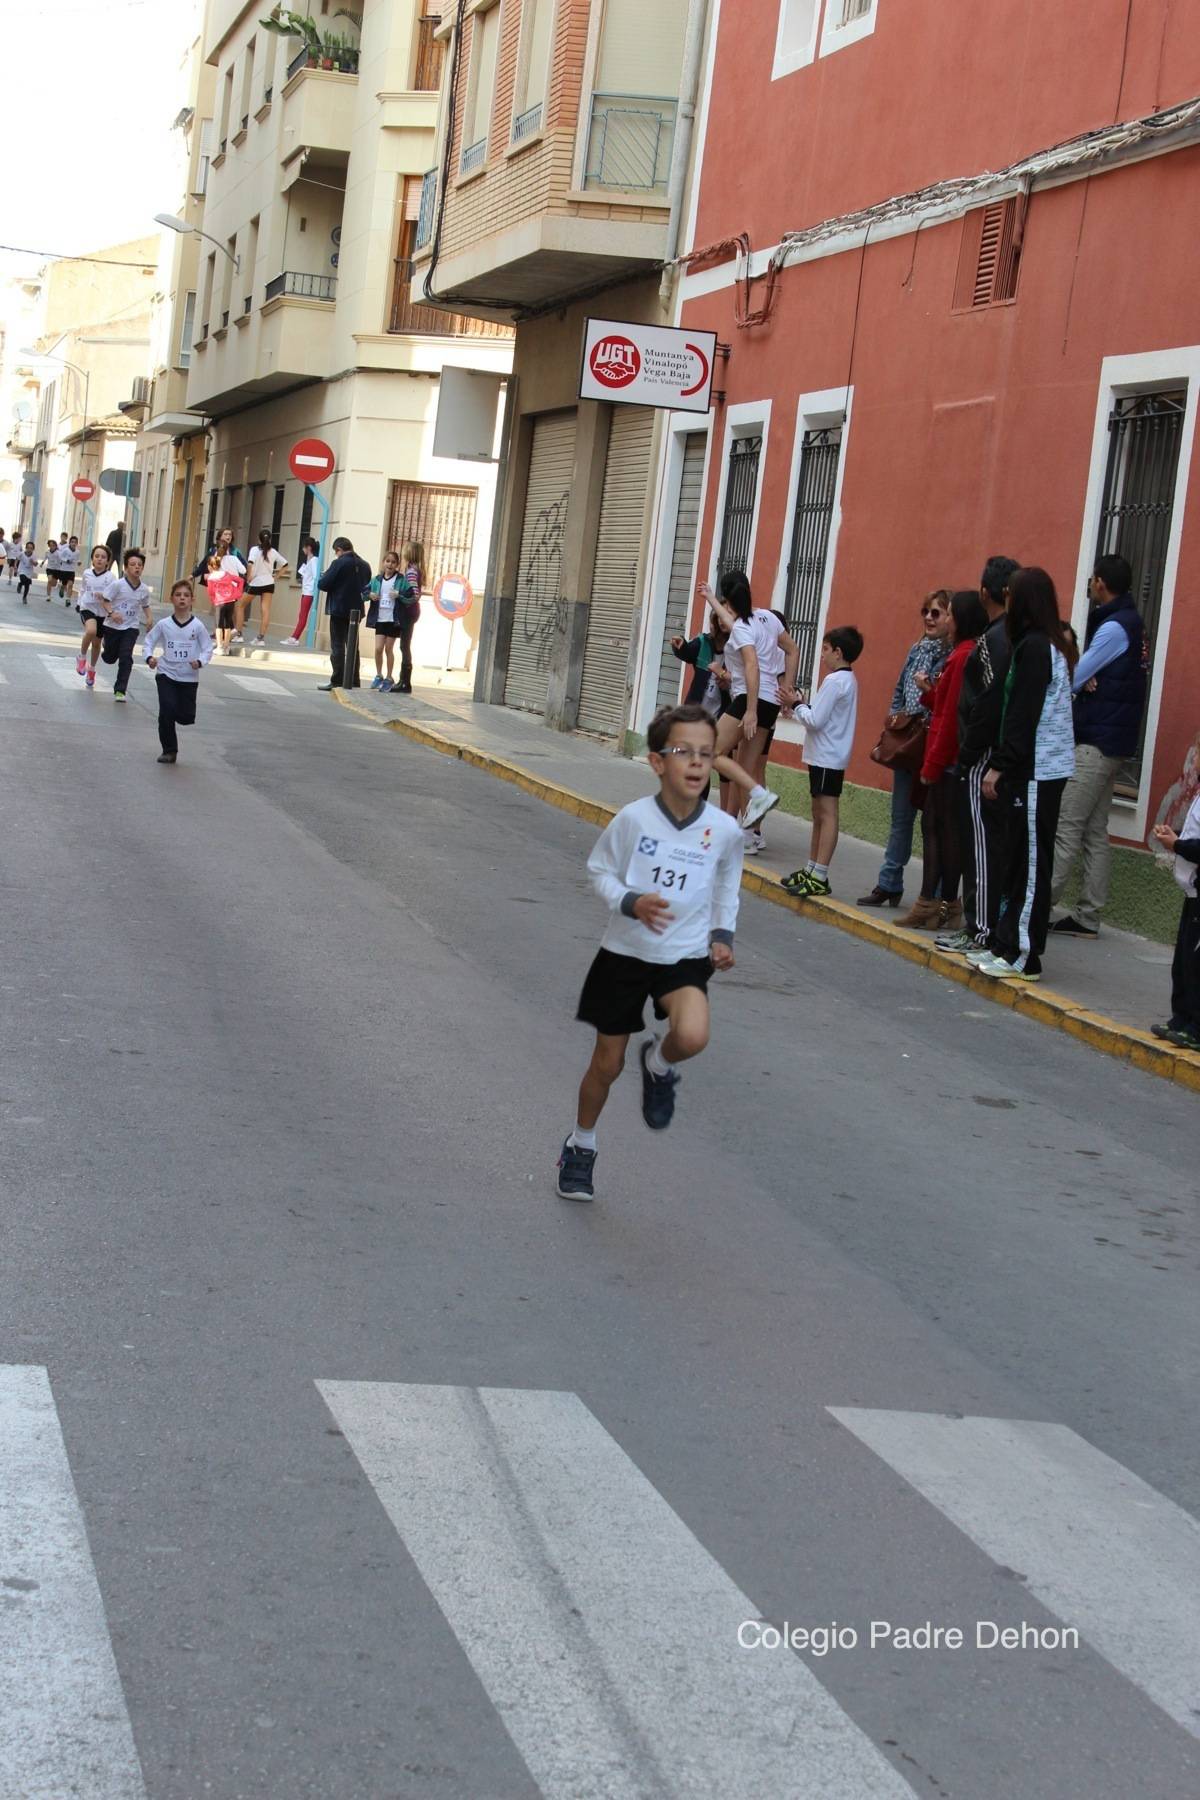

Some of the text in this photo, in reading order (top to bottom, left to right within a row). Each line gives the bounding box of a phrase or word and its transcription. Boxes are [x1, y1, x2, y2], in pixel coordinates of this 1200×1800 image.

[596, 342, 634, 366] UGT
[645, 349, 694, 361] Muntanya
[645, 358, 688, 370] Vinalopó
[644, 367, 691, 380] Vega Baja
[174, 650, 188, 658] 113
[651, 866, 688, 891] 131
